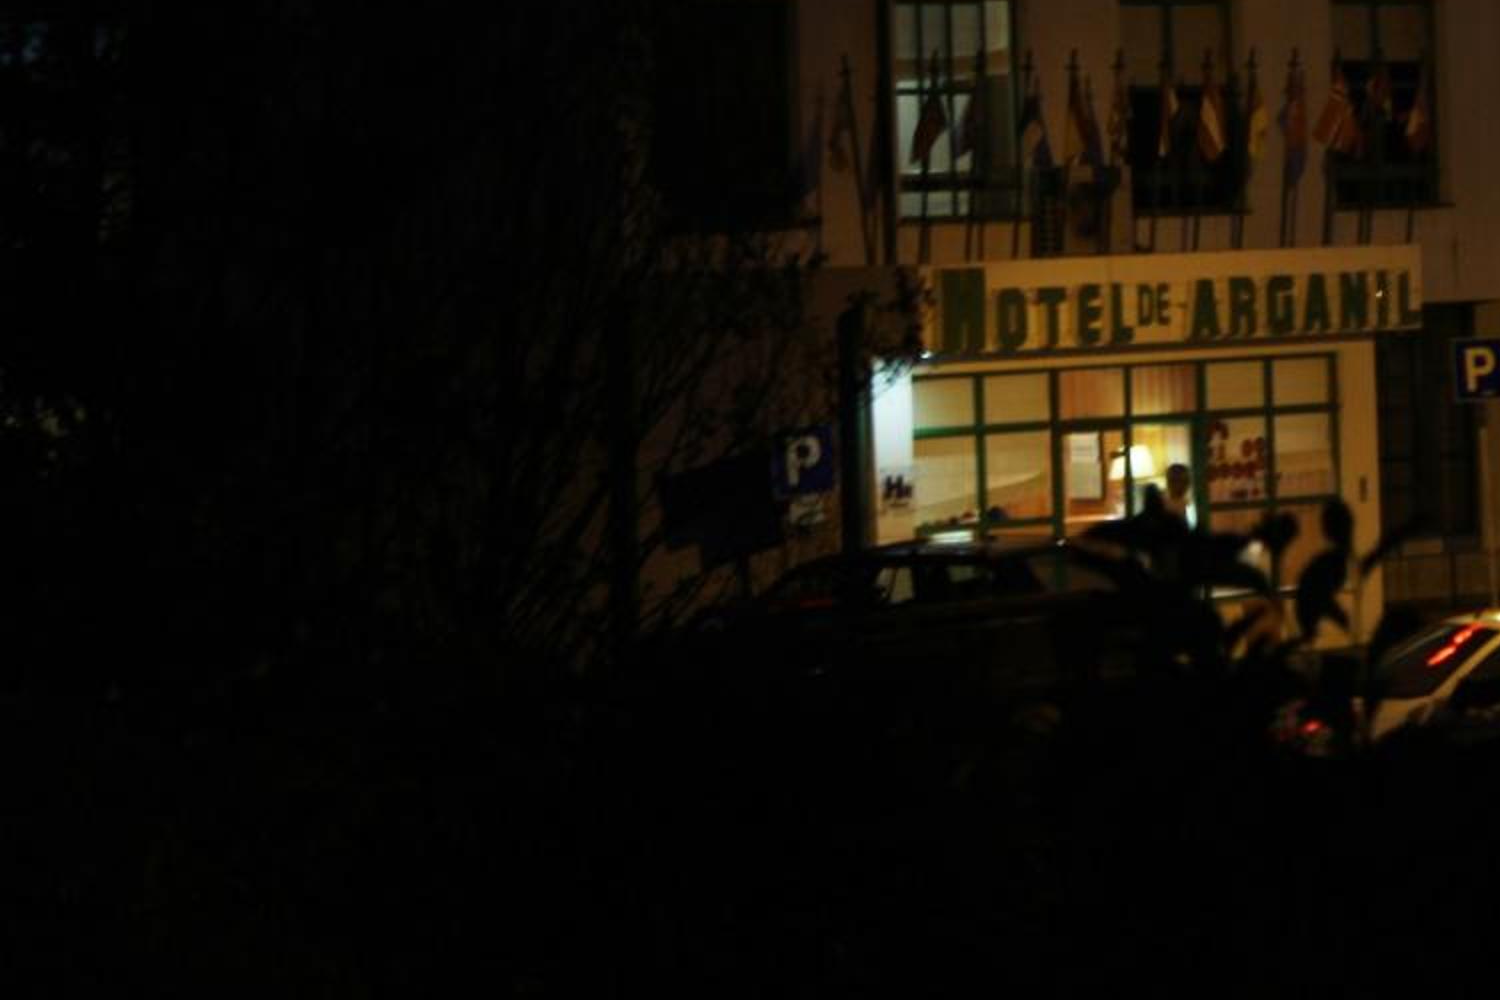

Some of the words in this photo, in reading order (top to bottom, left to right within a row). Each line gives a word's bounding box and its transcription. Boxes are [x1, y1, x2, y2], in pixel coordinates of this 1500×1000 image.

[938, 269, 1136, 353] HOTEL
[1136, 283, 1171, 327] DE
[1191, 269, 1424, 341] ARGANIL
[1465, 346, 1498, 393] P
[785, 434, 822, 488] P
